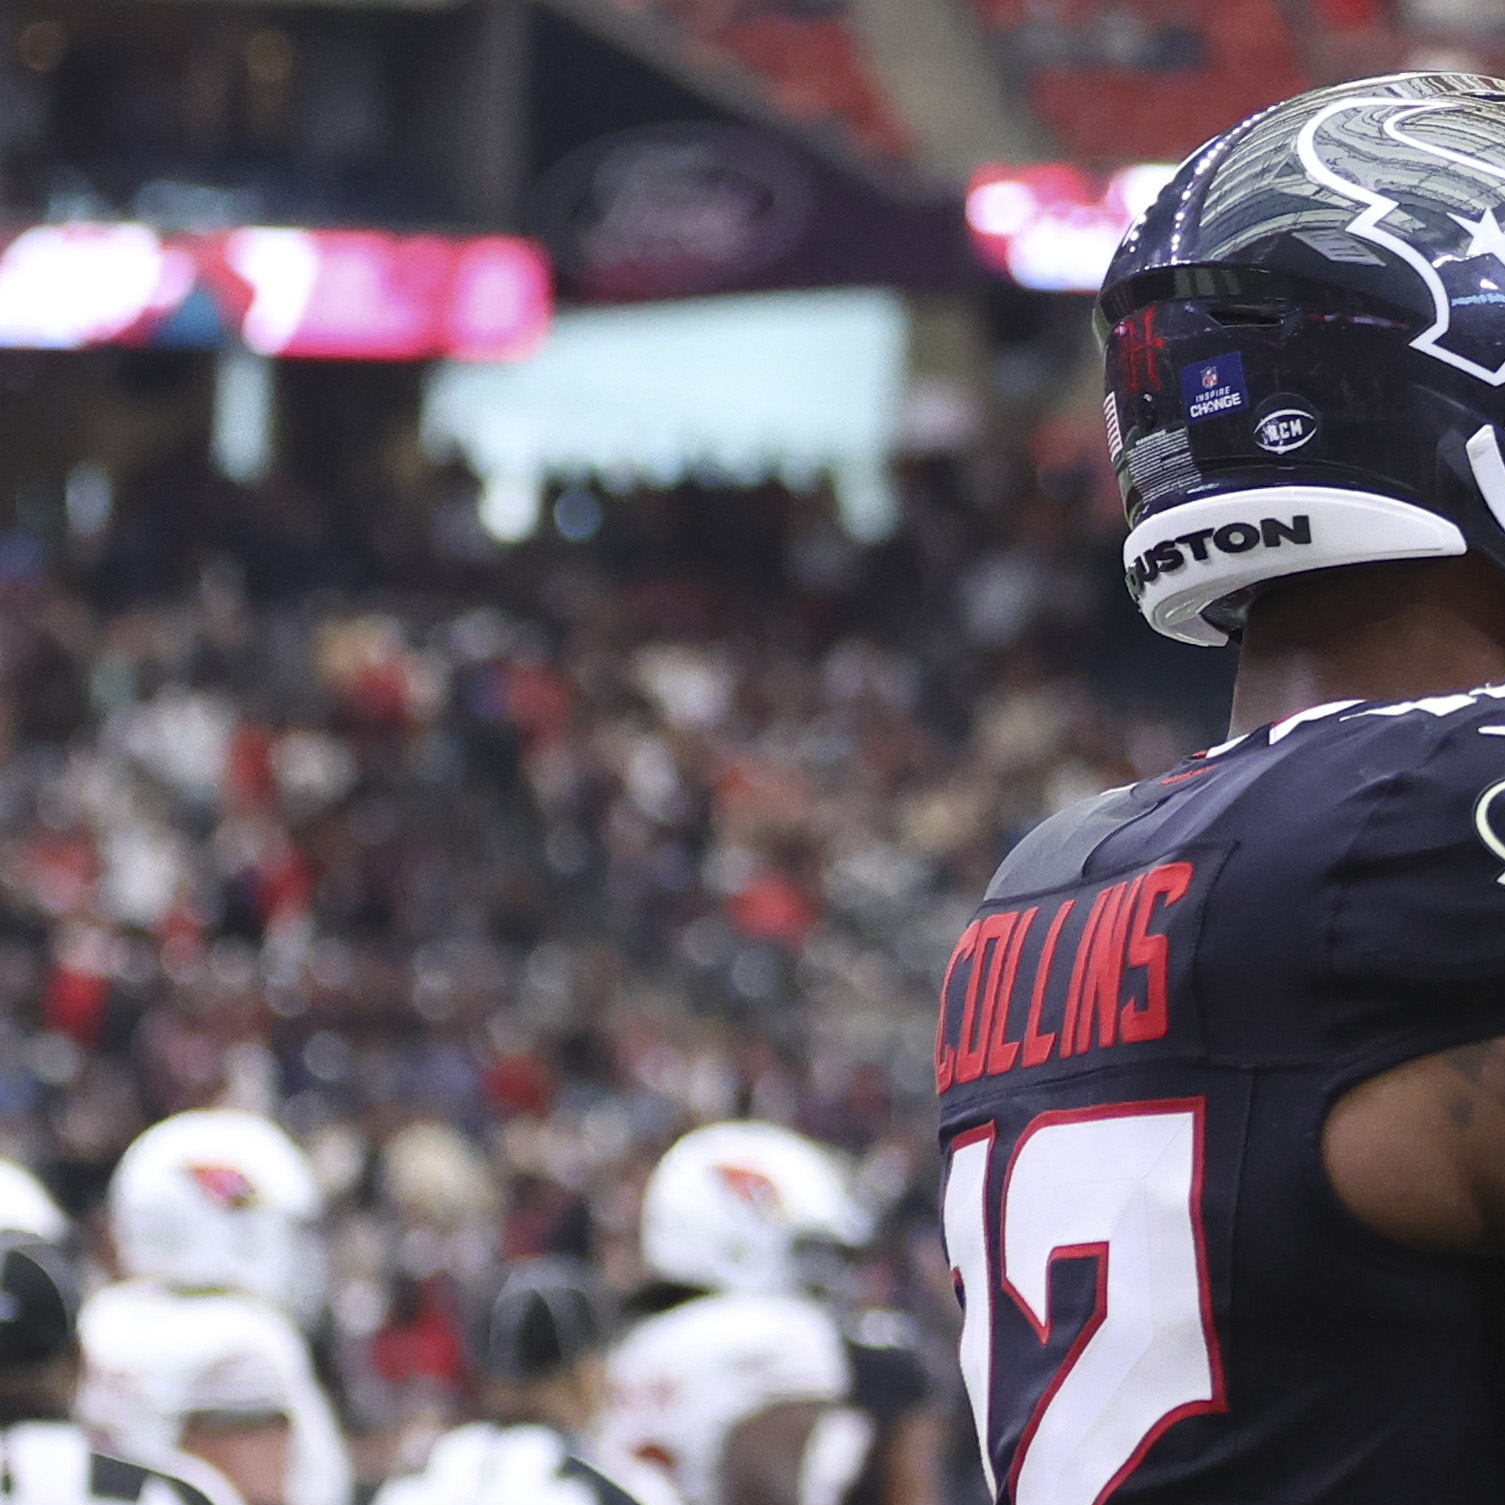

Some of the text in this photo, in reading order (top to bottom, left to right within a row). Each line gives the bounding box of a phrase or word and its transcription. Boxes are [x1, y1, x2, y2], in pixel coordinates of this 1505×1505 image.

[1190, 392, 1242, 418] CHANGE
[1195, 386, 1231, 403] INSPIRE
[934, 861, 1194, 1095] COLLINS
